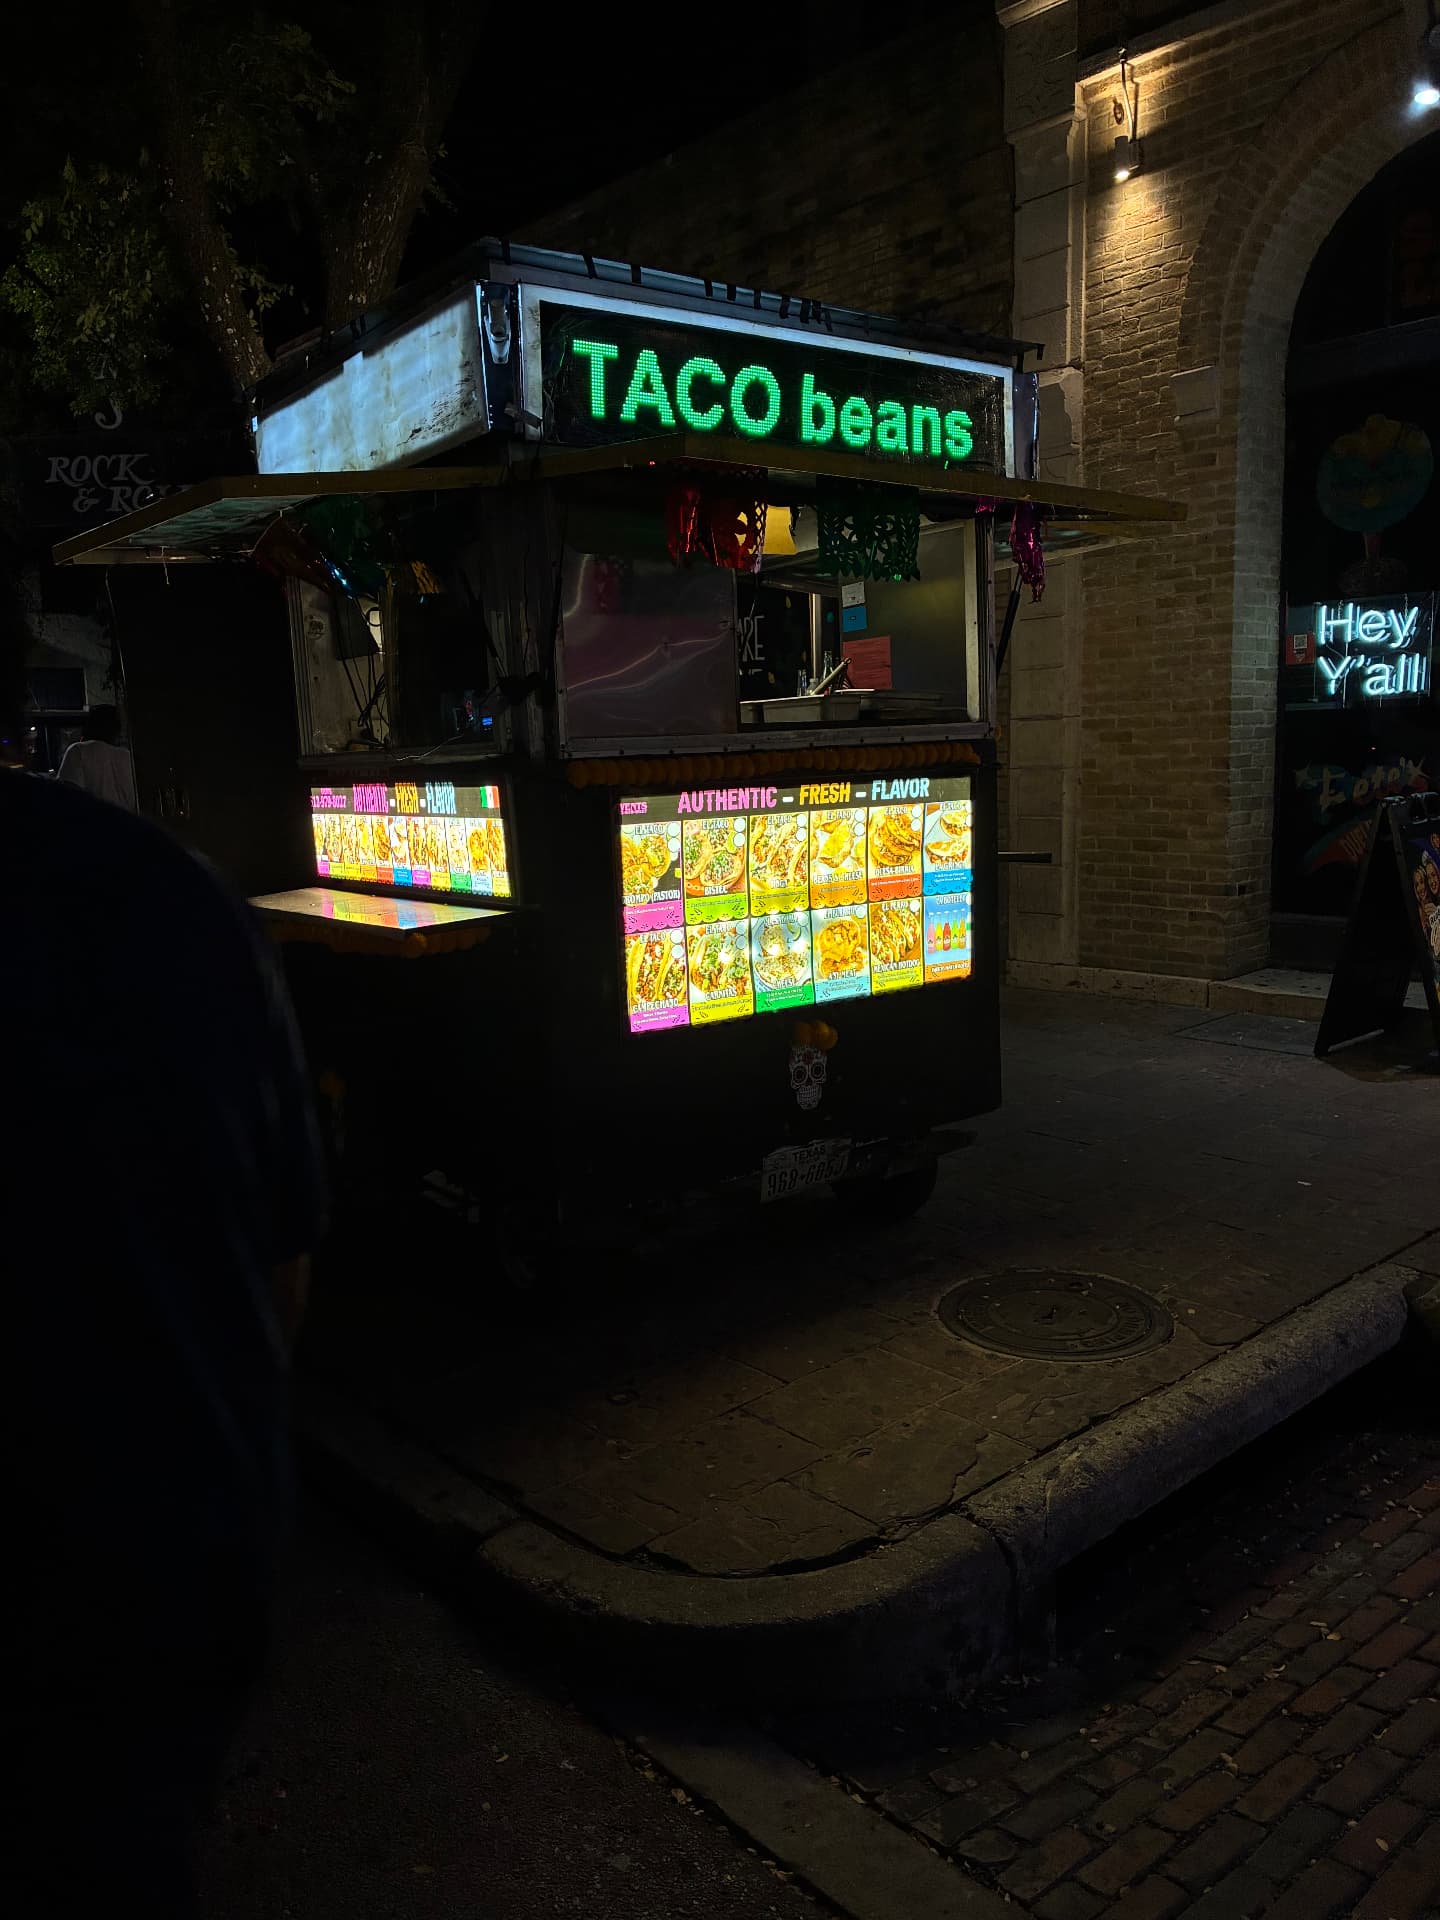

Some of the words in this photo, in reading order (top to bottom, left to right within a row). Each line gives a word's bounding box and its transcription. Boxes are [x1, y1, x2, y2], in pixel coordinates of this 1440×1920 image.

[572, 339, 781, 437] TACO
[801, 373, 973, 459] beans
[44, 452, 156, 489] ROCK
[72, 487, 100, 513] &
[1317, 602, 1418, 648] Hey
[1317, 653, 1421, 695] Y'all
[678, 787, 778, 814] AUTHENTIC
[799, 782, 851, 806] FRESH
[872, 778, 930, 801] FLAVOR
[704, 885, 728, 895] BISTEC
[793, 1145, 826, 1161] TEXAS
